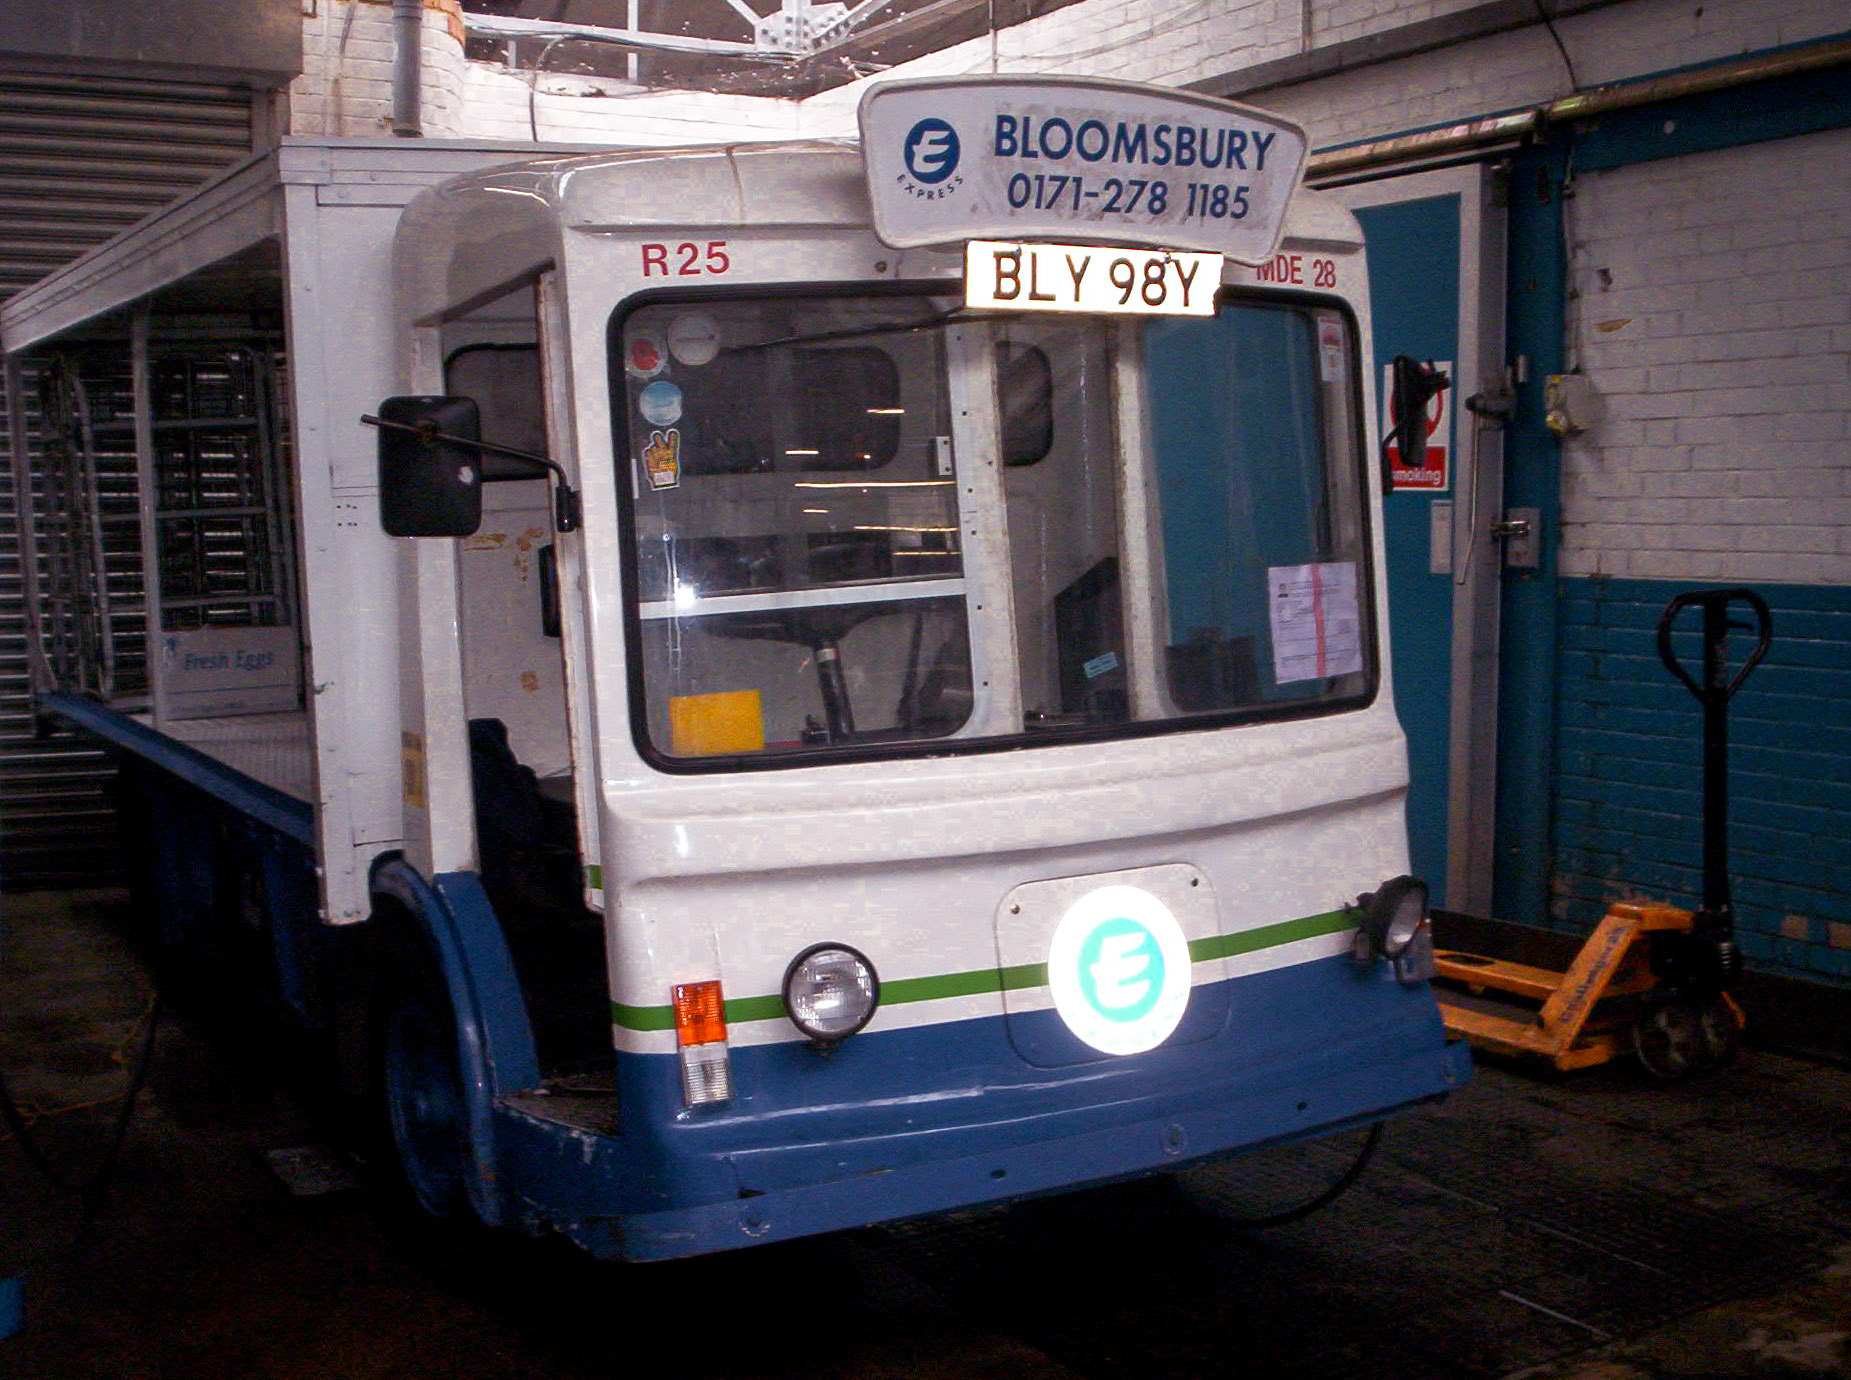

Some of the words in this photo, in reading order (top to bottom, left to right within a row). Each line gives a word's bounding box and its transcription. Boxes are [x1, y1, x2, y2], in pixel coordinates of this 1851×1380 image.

[994, 113, 1276, 171] BLOOMSBURY
[1007, 172, 1169, 215] 0171-278
[1188, 182, 1250, 219] 1185
[993, 250, 1092, 302] BLY
[1109, 257, 1200, 308] 98Y
[1256, 254, 1304, 285] MDE
[1313, 258, 1337, 288] 28
[184, 651, 230, 671] Fresh
[236, 649, 274, 672] Eggs
